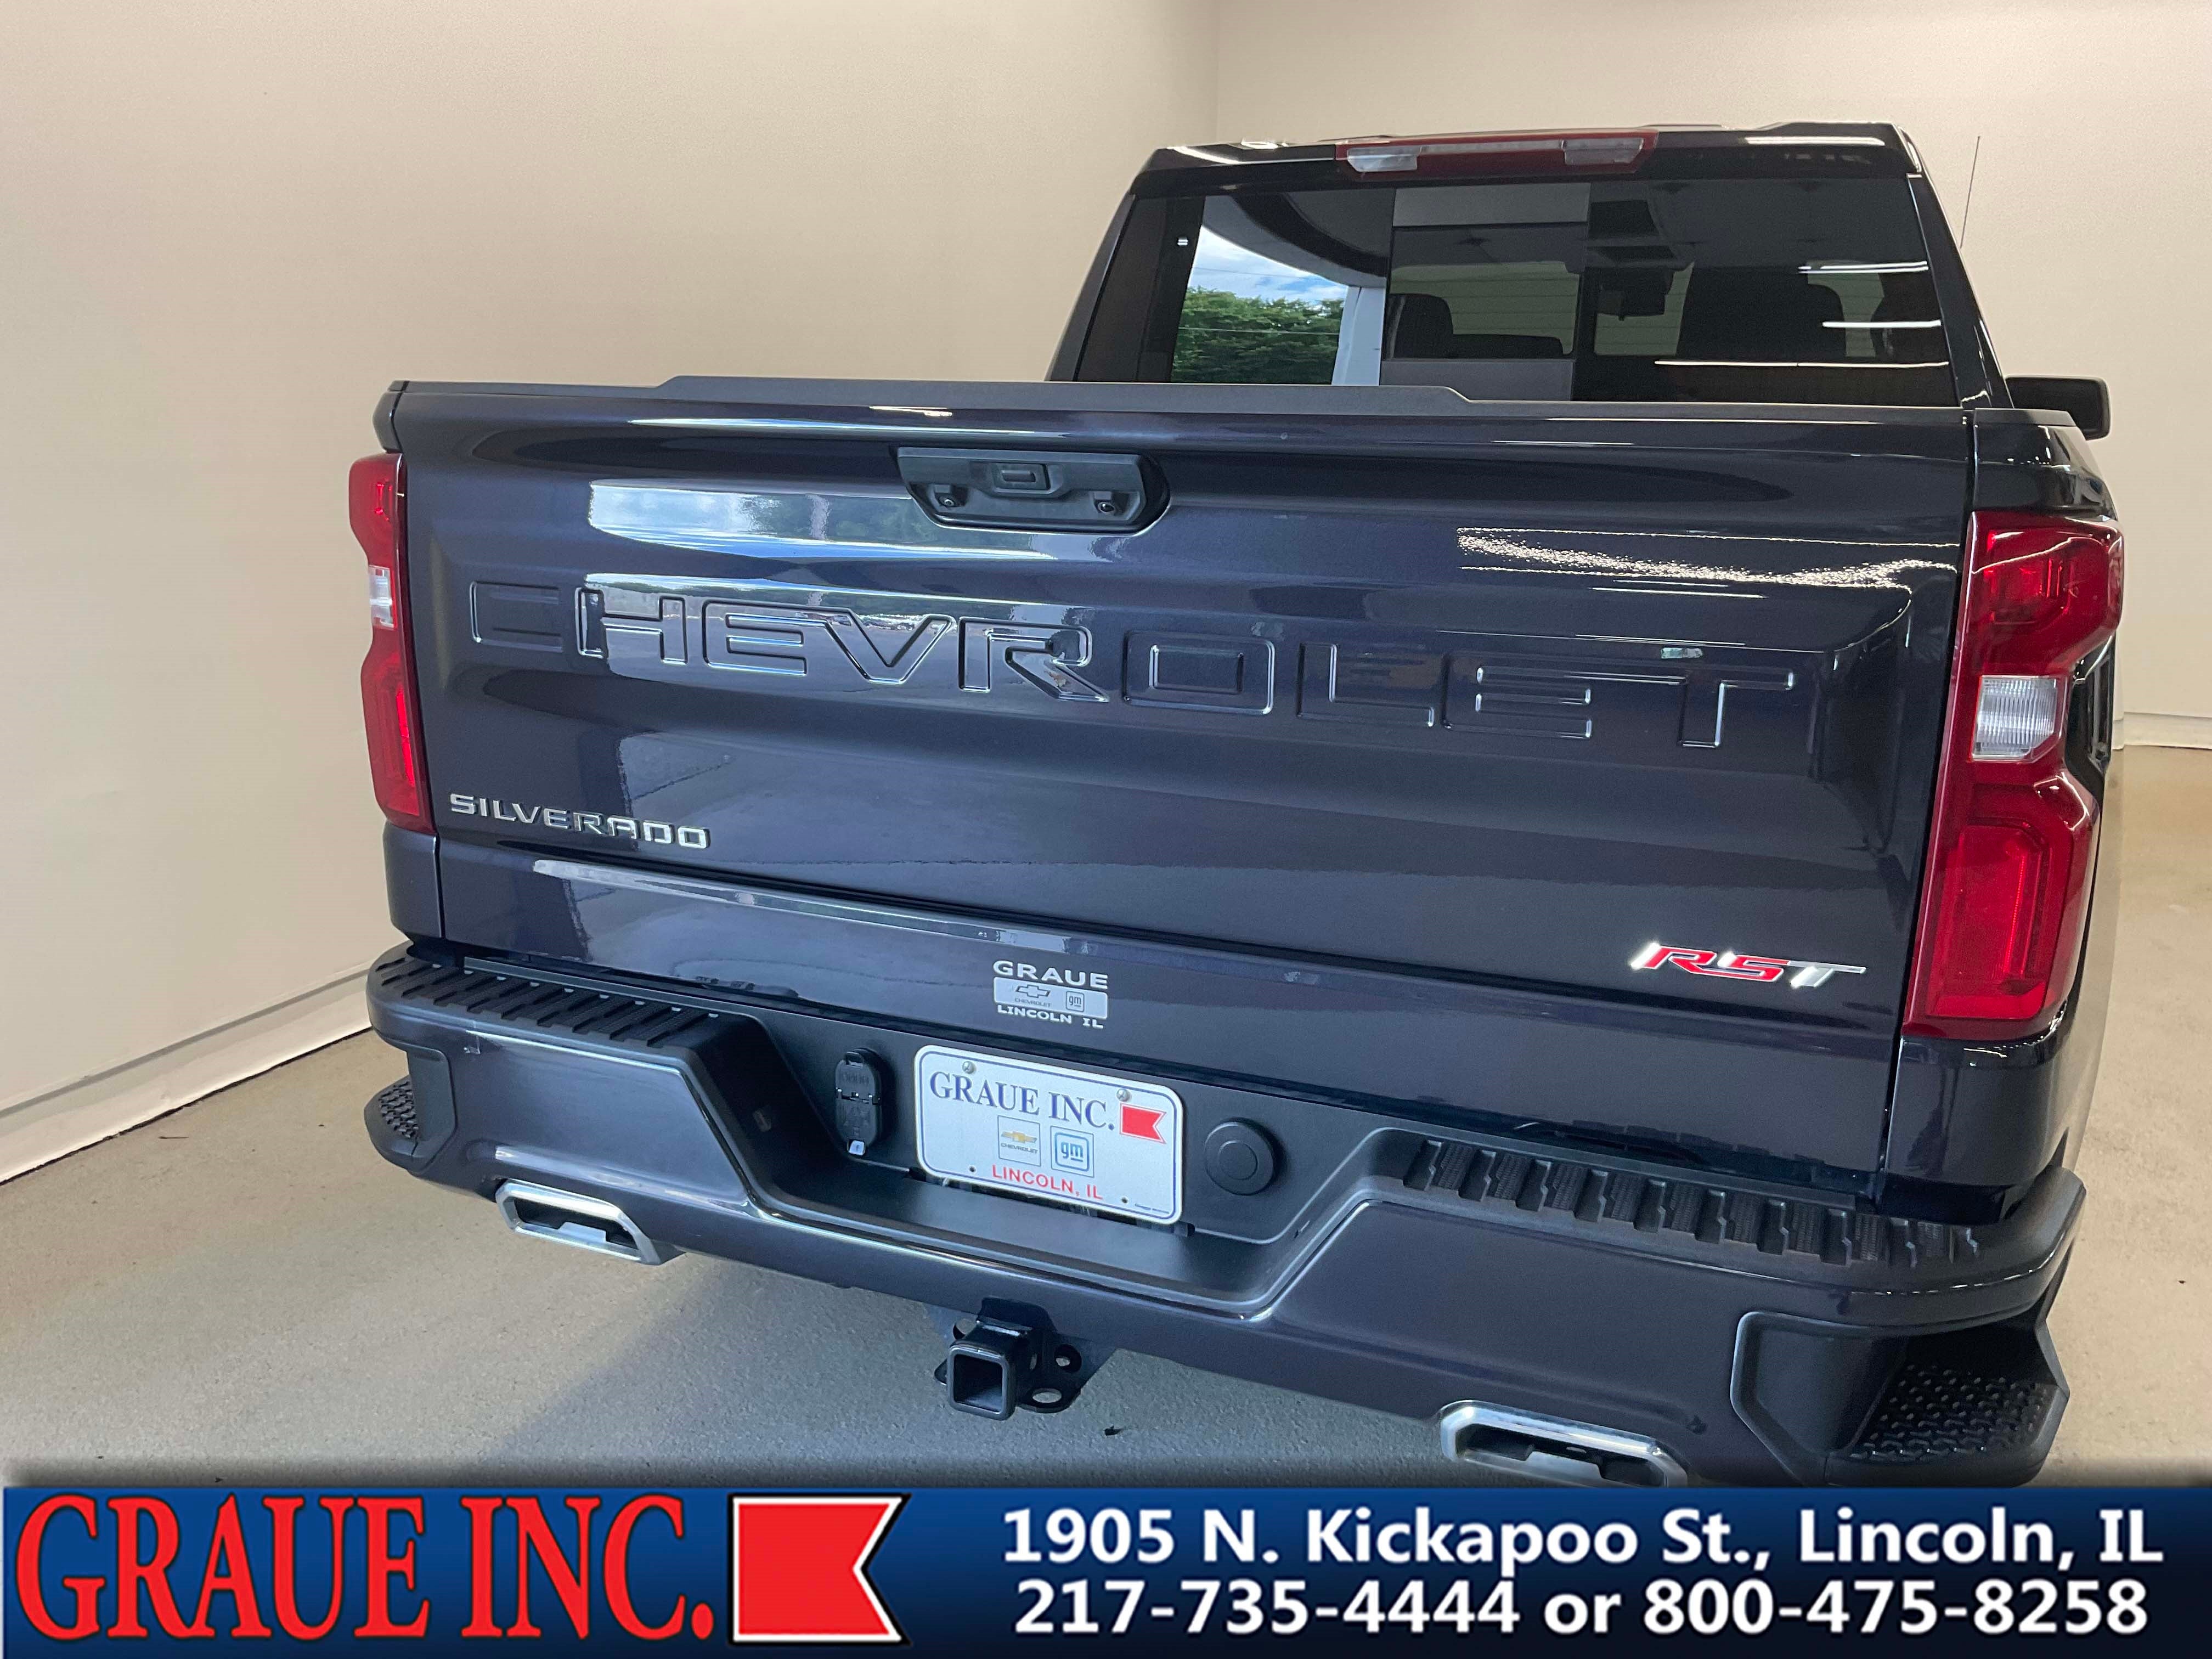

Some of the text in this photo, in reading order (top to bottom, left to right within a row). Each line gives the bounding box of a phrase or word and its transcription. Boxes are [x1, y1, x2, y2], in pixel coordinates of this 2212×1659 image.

[469, 580, 1797, 749] CHEVROLET
[449, 793, 710, 850] SILVERADO
[992, 960, 1108, 990] GRAUE
[1629, 941, 1867, 989] RST
[997, 1005, 1104, 1029] LINCOLN IL
[1015, 997, 1052, 1008] CHEVROLET
[929, 1071, 1115, 1131] GRAUE INC.
[1000, 1142, 1039, 1154] CHEVROLET
[1060, 1141, 1084, 1163] gm
[992, 1164, 1103, 1200] LINCOLN, IL
